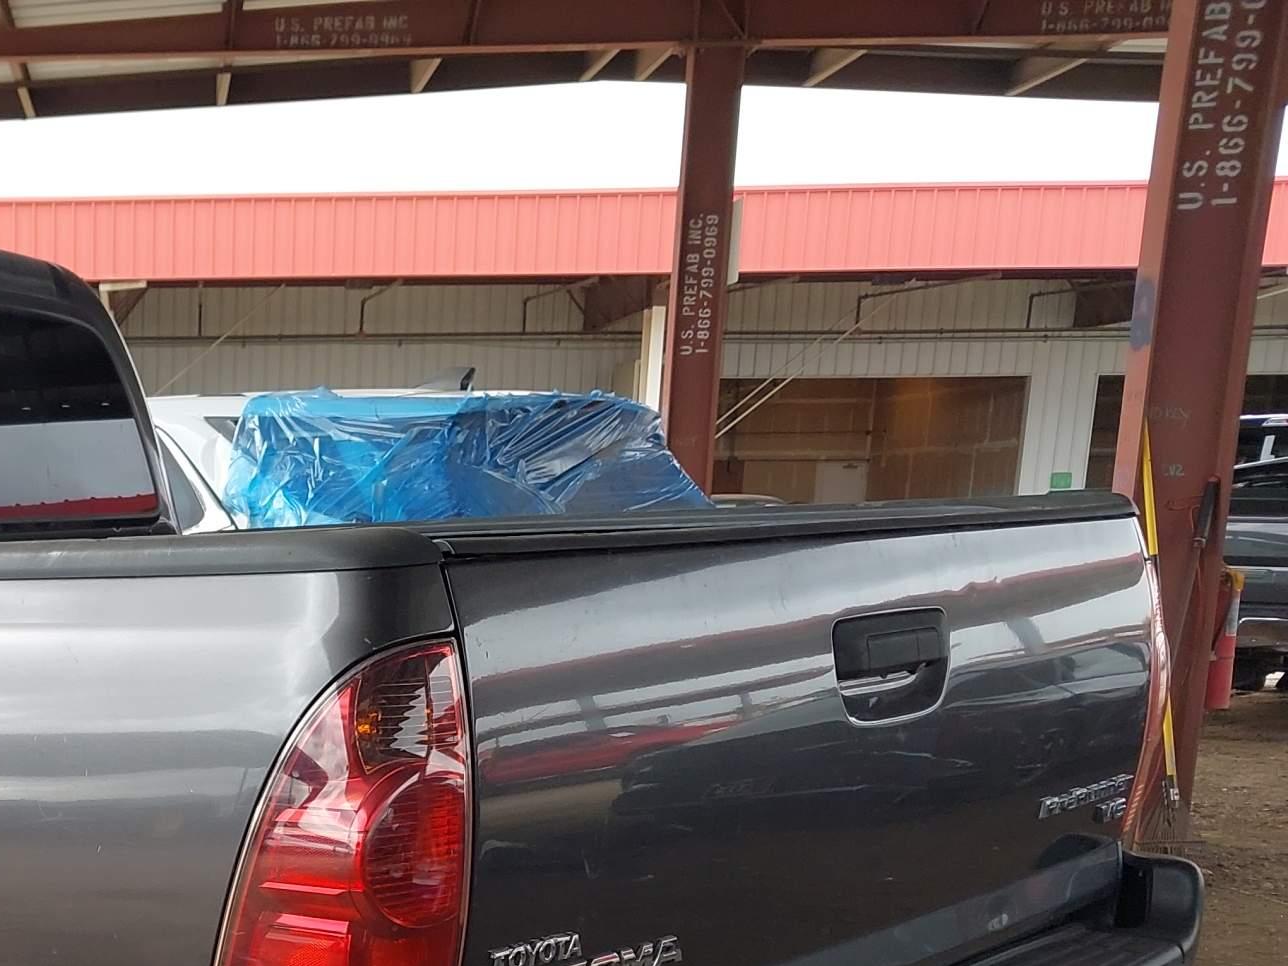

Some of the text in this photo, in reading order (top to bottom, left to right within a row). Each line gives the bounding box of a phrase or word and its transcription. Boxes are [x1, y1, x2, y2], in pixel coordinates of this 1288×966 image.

[313, 16, 375, 31] PREFAB
[1177, 1, 1232, 210] U.S. PREFAB
[680, 213, 704, 355] U.S. PREFAB INC.
[696, 215, 719, 353] 1-866-799-0969
